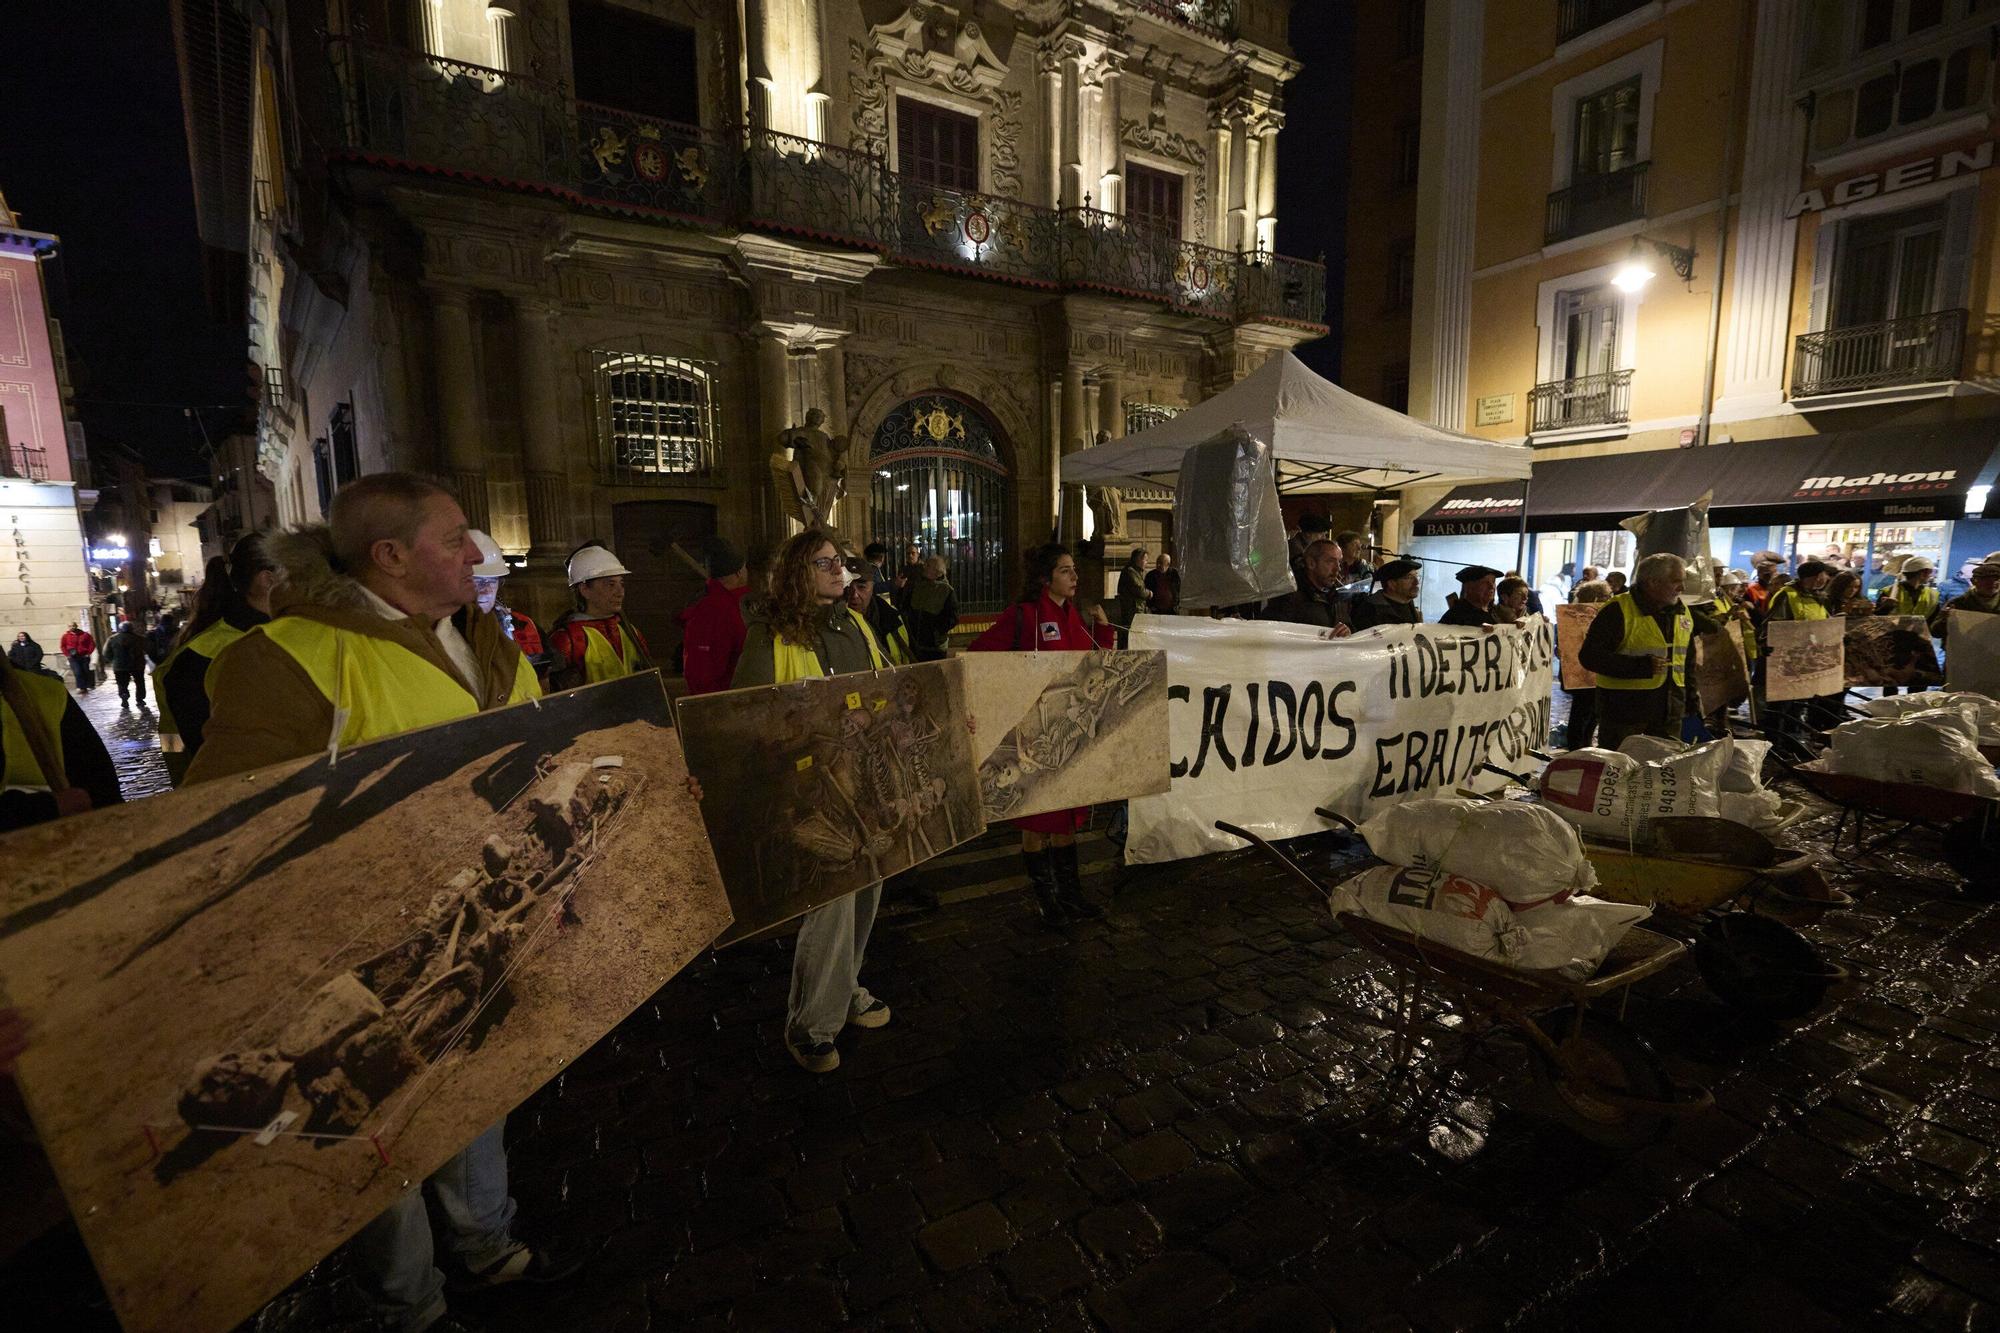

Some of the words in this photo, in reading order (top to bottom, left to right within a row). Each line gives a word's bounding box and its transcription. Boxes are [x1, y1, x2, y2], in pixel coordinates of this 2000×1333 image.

[1786, 141, 1994, 219] AGEN
[1793, 486, 1873, 498] DESDE
[1887, 482, 1949, 494] 1890
[1800, 470, 1957, 490] Mahou
[1426, 523, 1456, 535] BAR
[1659, 790, 1677, 813] 948
